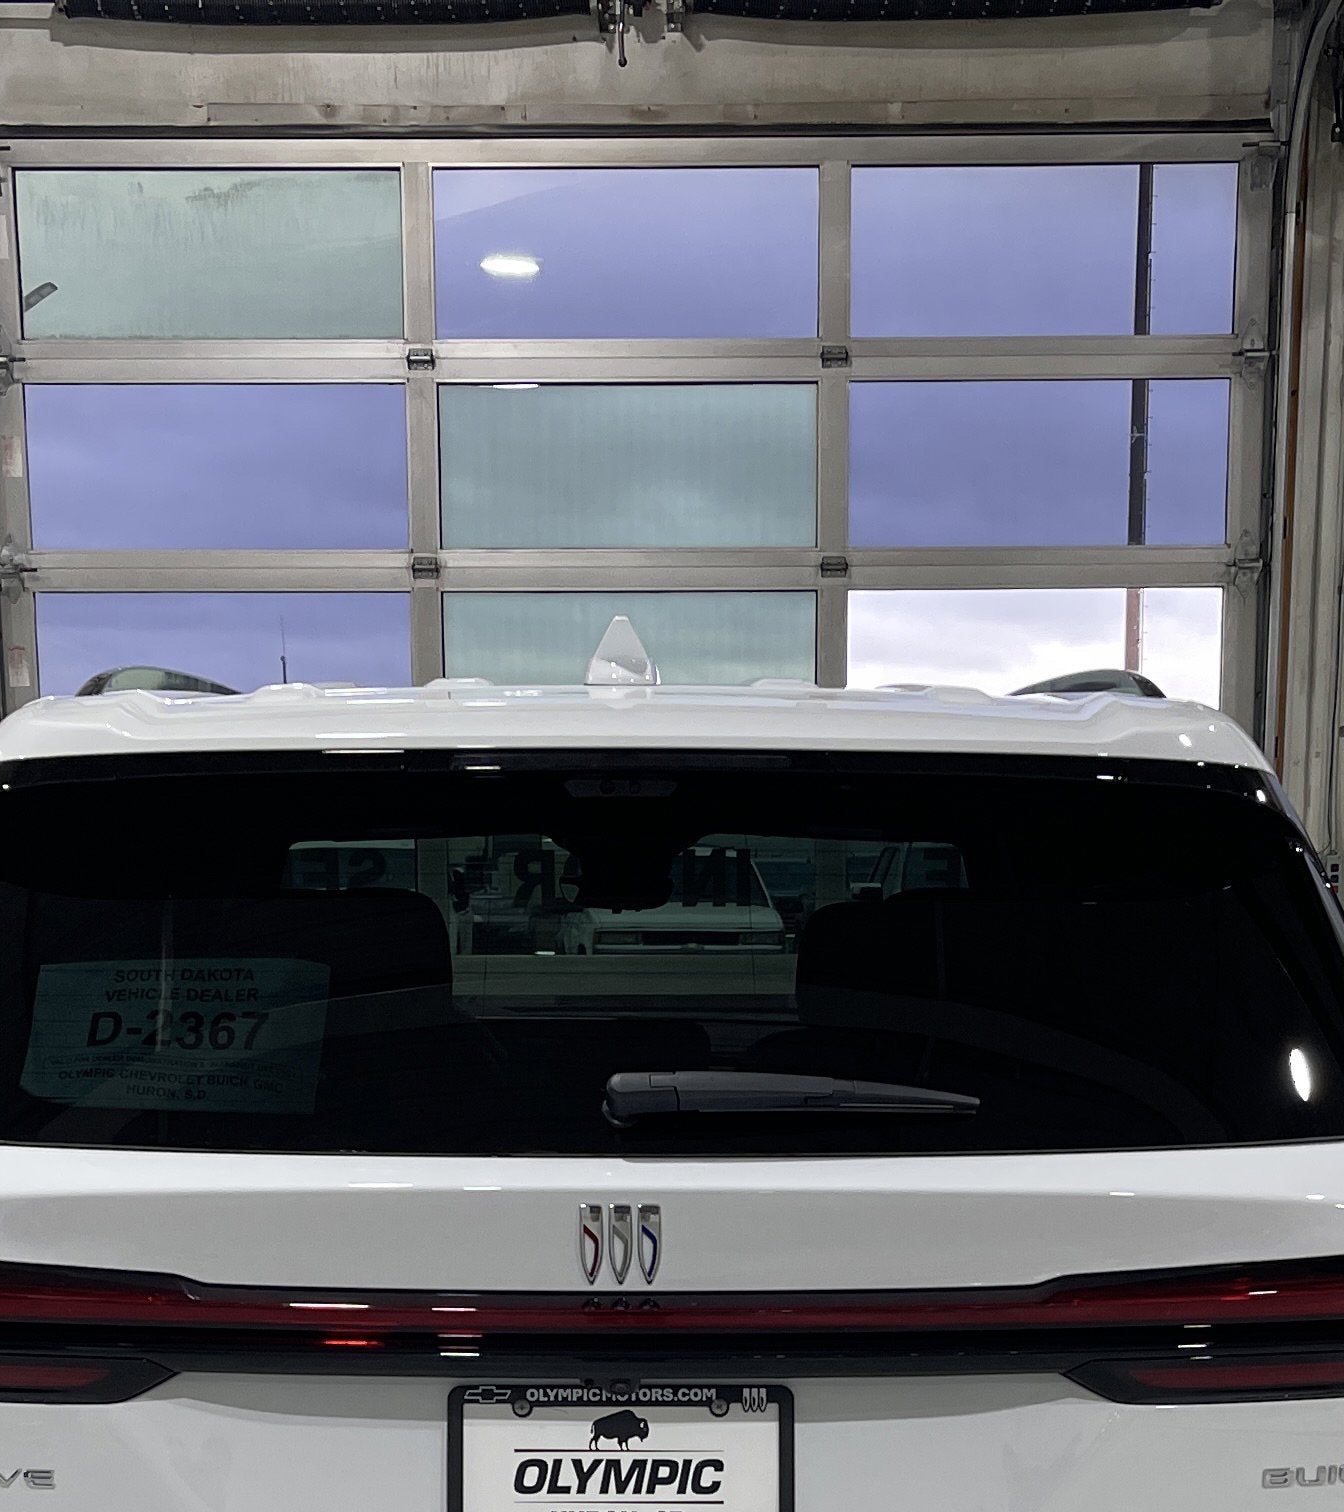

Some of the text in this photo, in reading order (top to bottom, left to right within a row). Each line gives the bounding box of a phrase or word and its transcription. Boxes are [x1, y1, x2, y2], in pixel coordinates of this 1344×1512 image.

[181, 967, 255, 983] DAKOTA
[105, 986, 259, 1003] VEHICE DEALER
[86, 1009, 270, 1051] D-2367
[57, 1067, 284, 1093] OLYMPIC CHEVROLET BUICK GMC
[514, 1458, 724, 1495] OLYMPIC
